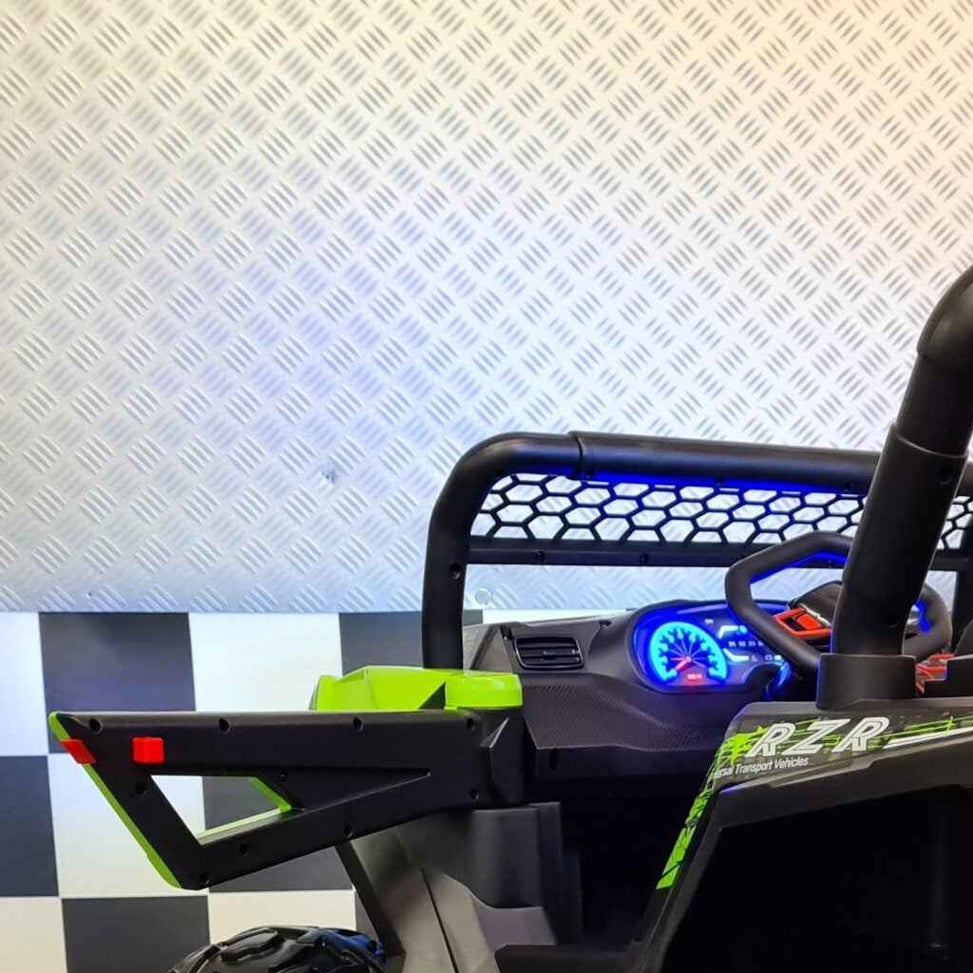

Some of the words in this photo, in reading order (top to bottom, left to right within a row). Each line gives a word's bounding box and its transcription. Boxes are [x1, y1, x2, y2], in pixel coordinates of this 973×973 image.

[744, 716, 890, 758] RZR
[735, 759, 773, 774] Transport
[774, 757, 808, 769] Vehicles
